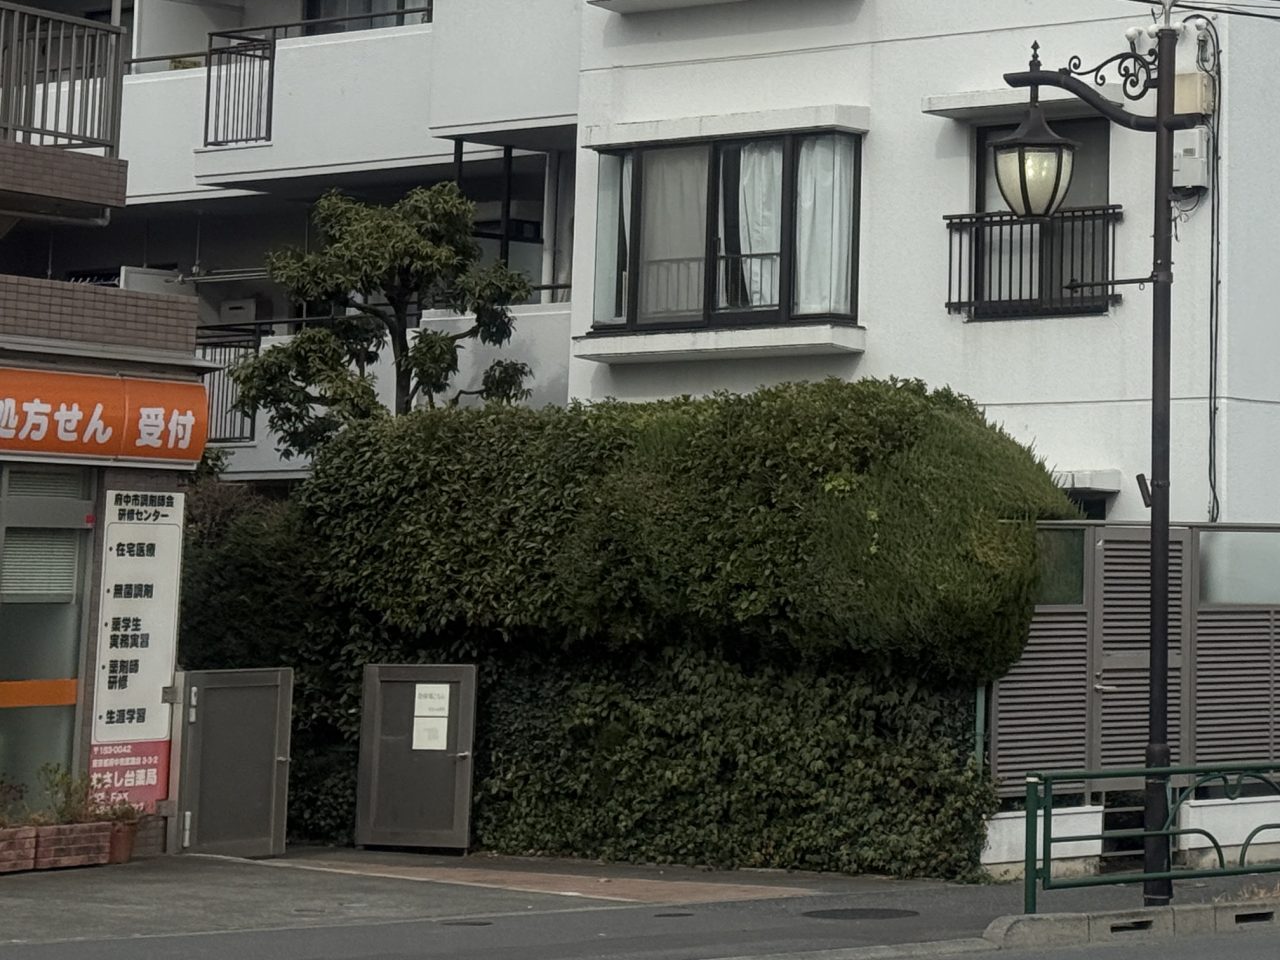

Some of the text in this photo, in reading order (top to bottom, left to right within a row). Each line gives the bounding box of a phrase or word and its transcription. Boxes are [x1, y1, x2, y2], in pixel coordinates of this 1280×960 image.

[135, 407, 195, 450] 受付
[118, 508, 170, 522] 研修センター
[109, 633, 150, 649] 実務実習
[107, 675, 129, 690] 研修
